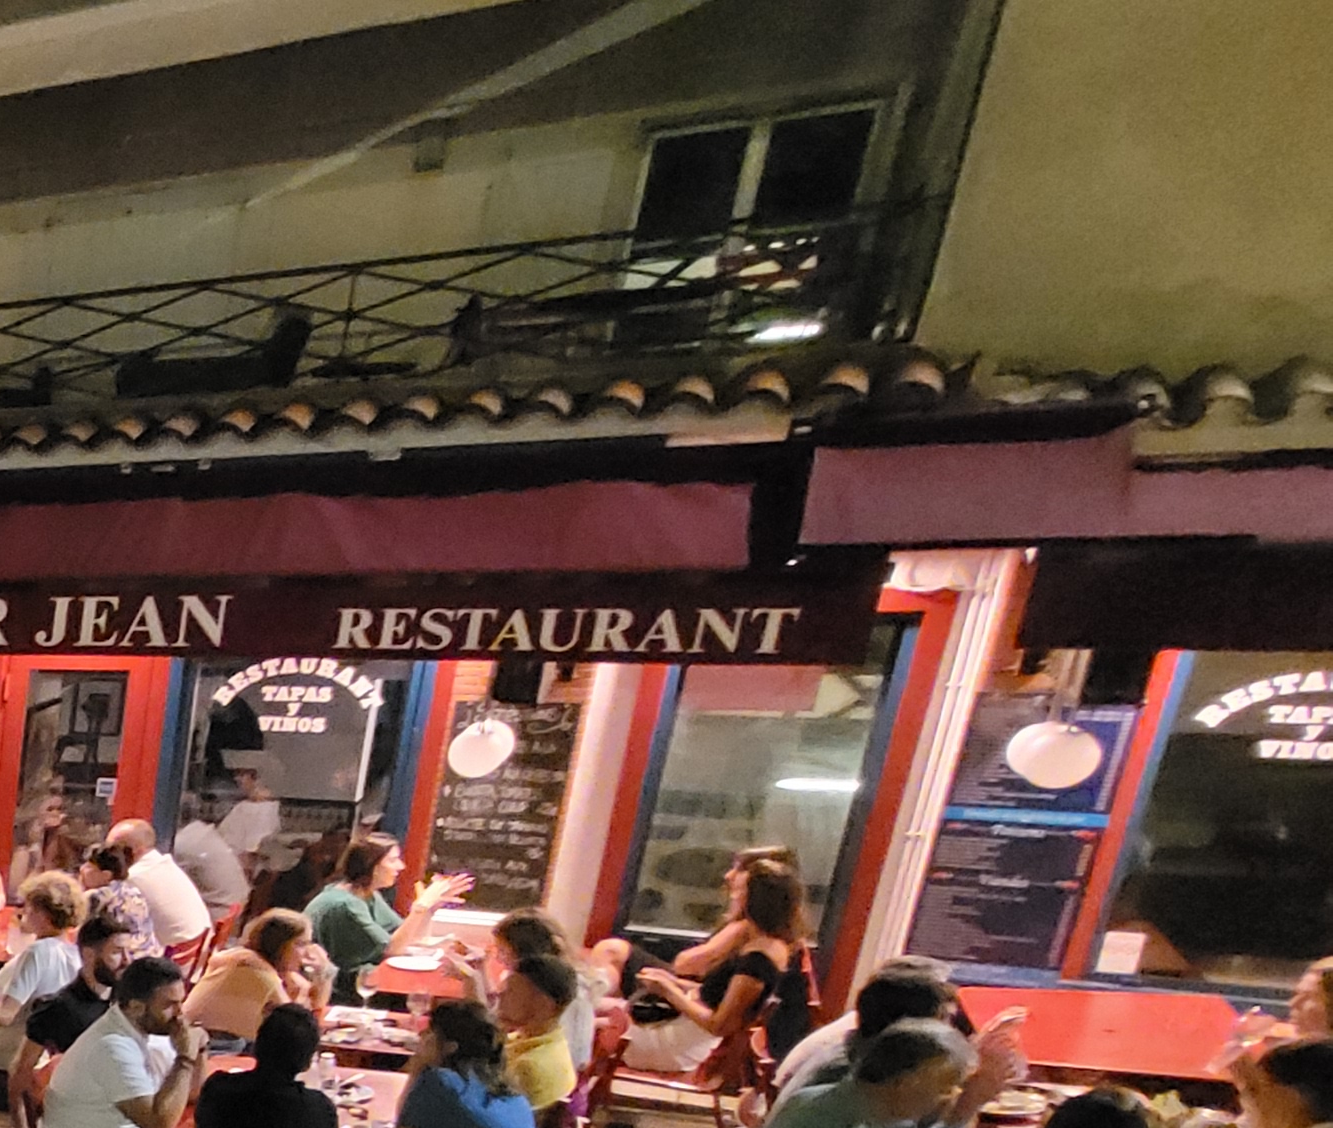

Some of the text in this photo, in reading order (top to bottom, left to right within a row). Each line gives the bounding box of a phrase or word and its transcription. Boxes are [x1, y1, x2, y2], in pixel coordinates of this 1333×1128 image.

[35, 595, 234, 648] JEAN
[331, 607, 801, 655] RESTAURANT
[212, 657, 385, 710] RESTAURANT
[261, 686, 334, 703] TAPAS
[1194, 671, 1333, 728] RESTA
[257, 716, 328, 733] VINOS
